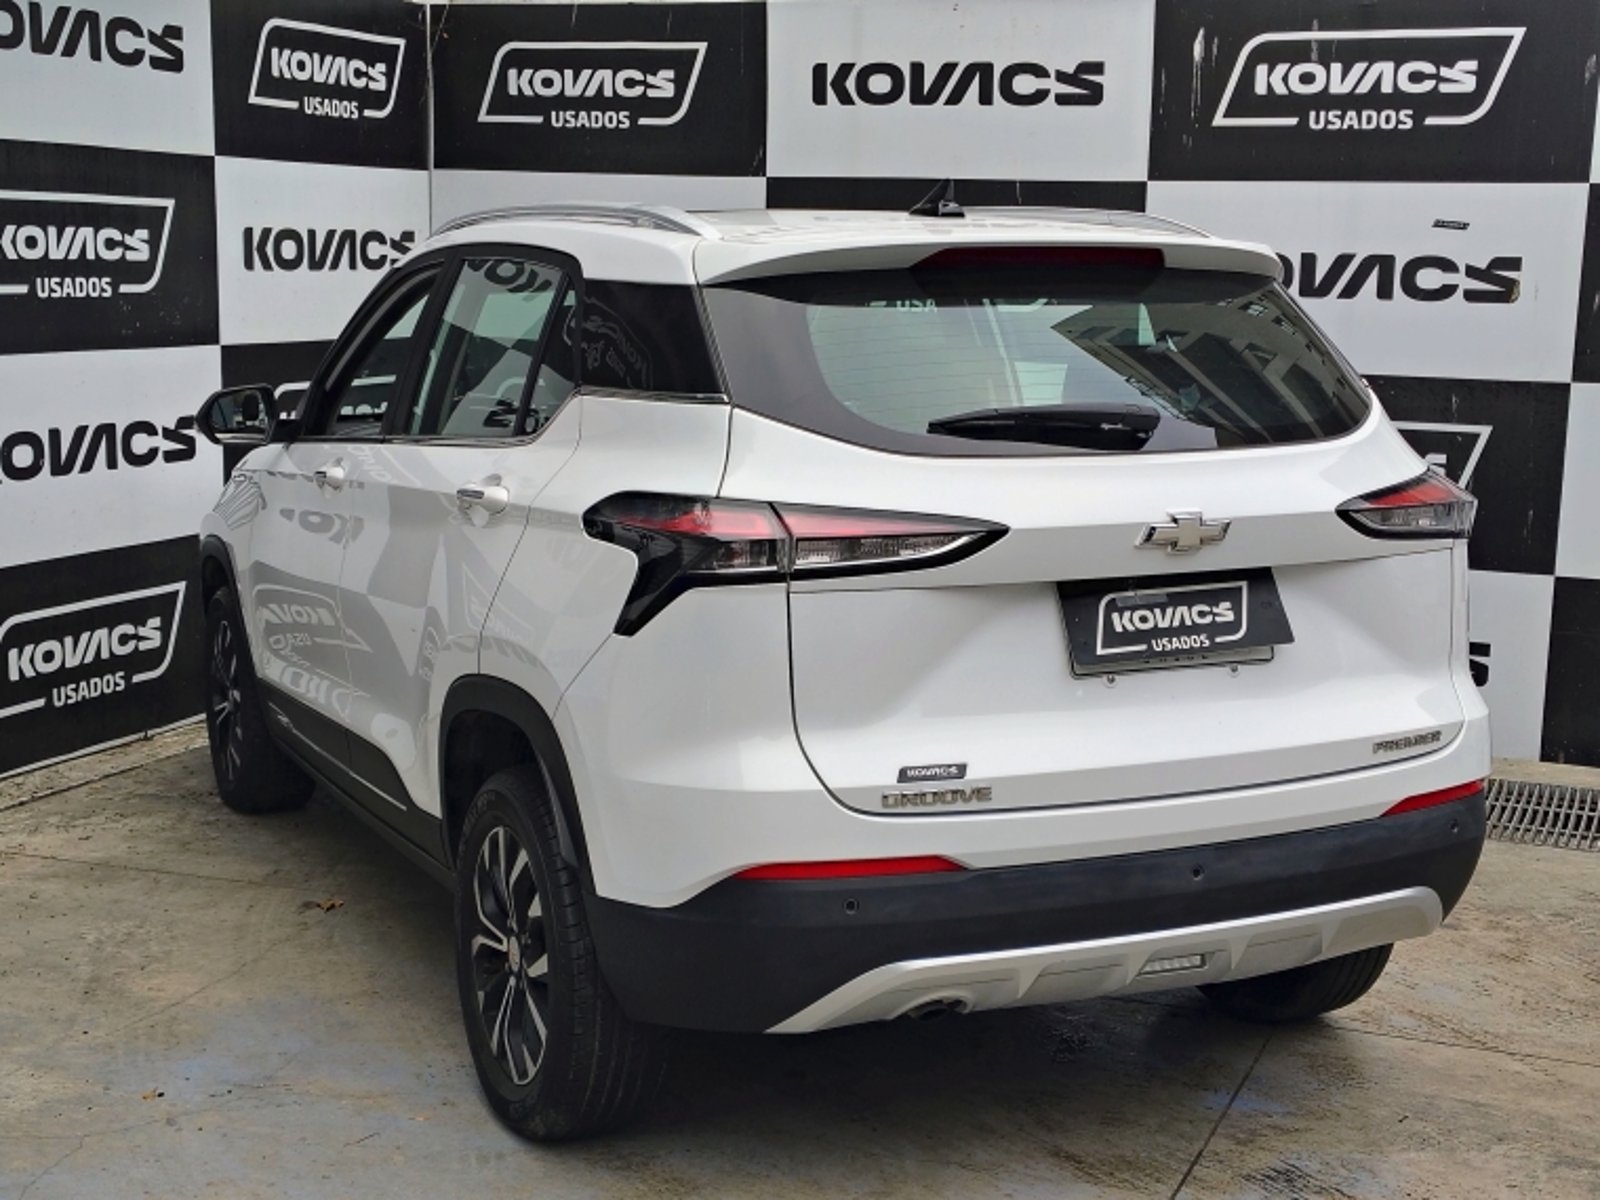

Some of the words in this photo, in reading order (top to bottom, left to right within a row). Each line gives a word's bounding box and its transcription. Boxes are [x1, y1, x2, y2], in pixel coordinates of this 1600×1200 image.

[271, 47, 387, 91] KOVACS
[507, 68, 675, 98] KOVACS
[812, 61, 1105, 106] KOVACS
[1254, 60, 1479, 95] KOVACS
[304, 97, 359, 119] USADOS
[551, 110, 631, 129] USADOS
[1308, 109, 1413, 130] USADOS
[36, 277, 112, 298] USADOS
[0, 415, 196, 484] OVACS
[1111, 601, 1235, 632] KOVACS
[8, 616, 162, 682] KOVACS
[1151, 634, 1210, 651] USADOS
[52, 671, 126, 707] USADOS
